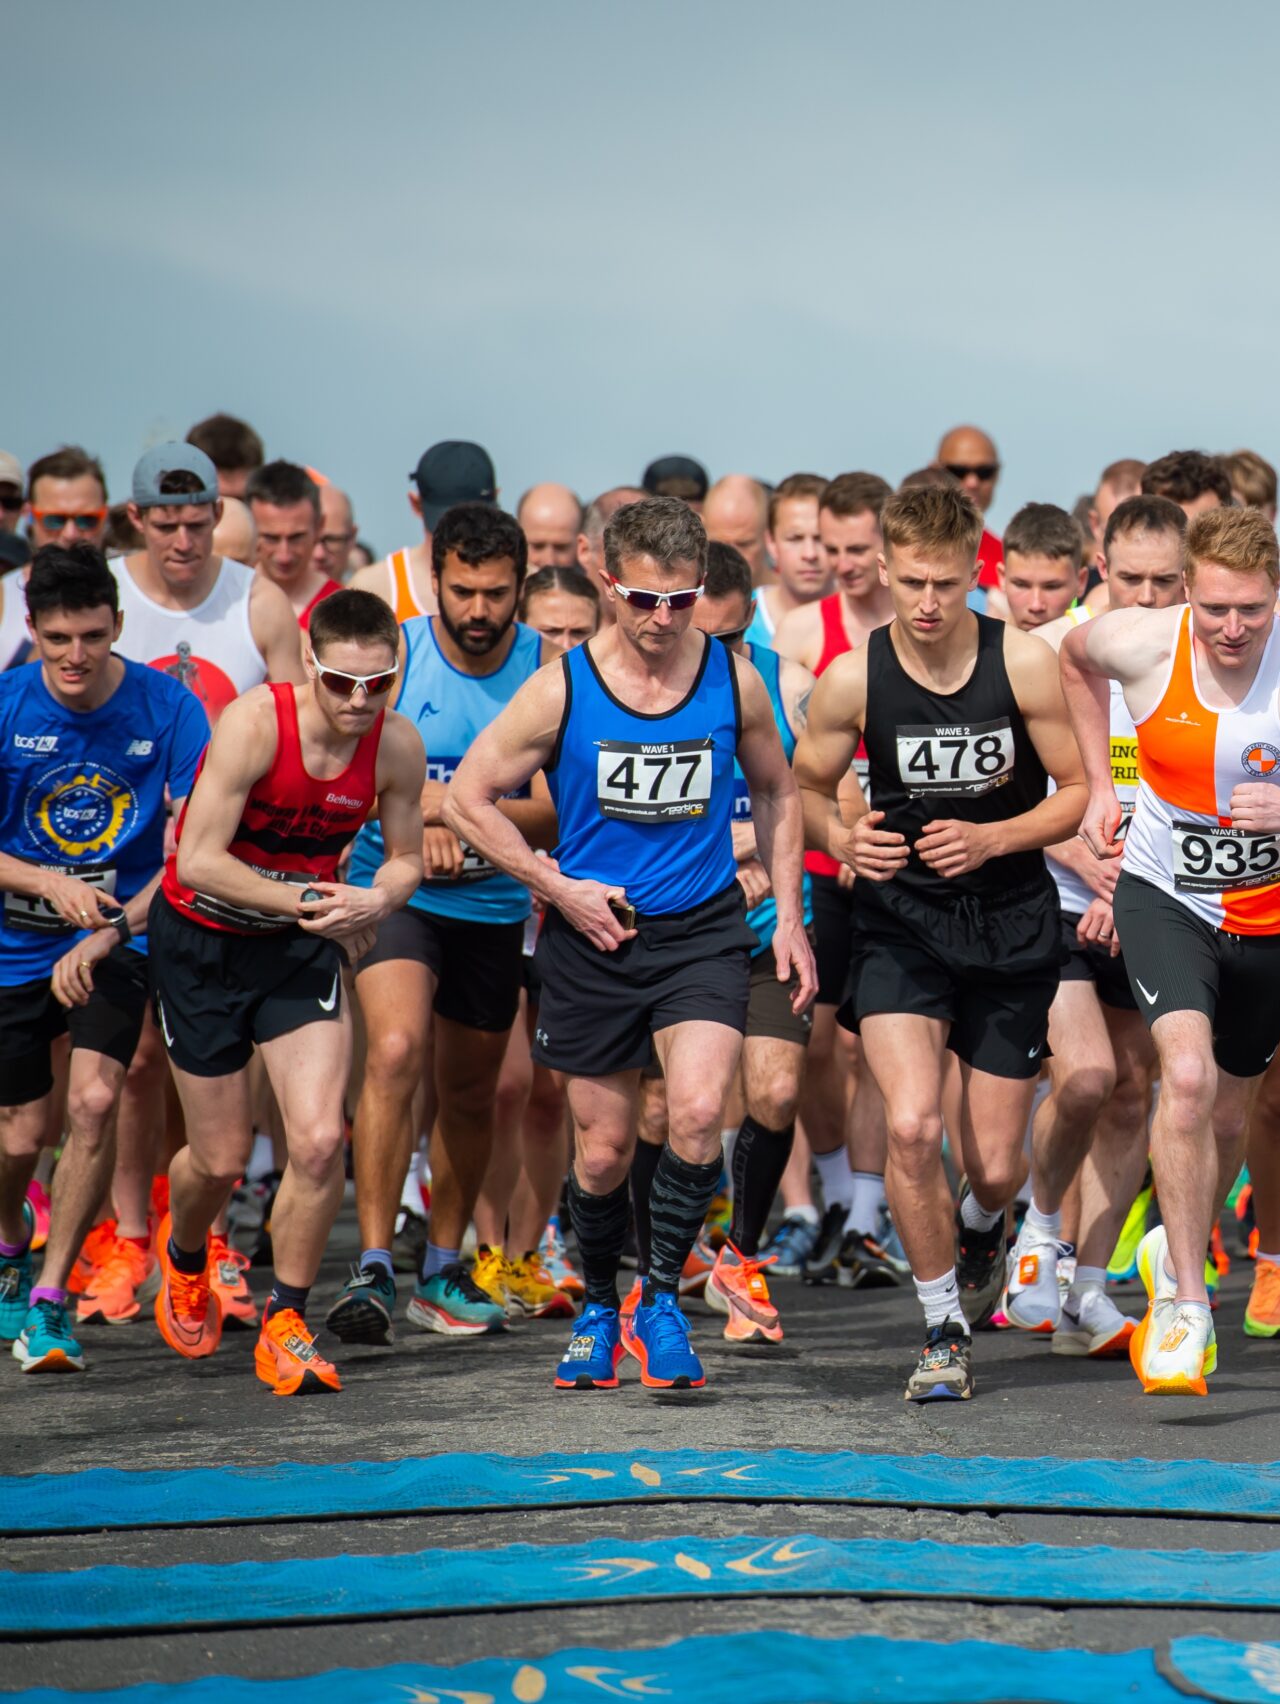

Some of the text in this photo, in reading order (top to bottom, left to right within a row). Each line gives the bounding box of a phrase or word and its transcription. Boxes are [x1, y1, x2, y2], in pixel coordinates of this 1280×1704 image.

[935, 727, 970, 736] WAVE 2
[641, 745, 669, 754] WAVE
[908, 735, 1006, 780] 478
[606, 754, 702, 800] 477
[326, 793, 363, 809] Bellway
[1210, 828, 1239, 837] WAVE
[1181, 835, 1280, 877] 935
[40, 863, 75, 874] WAVE 1
[252, 864, 279, 880] WAVE
